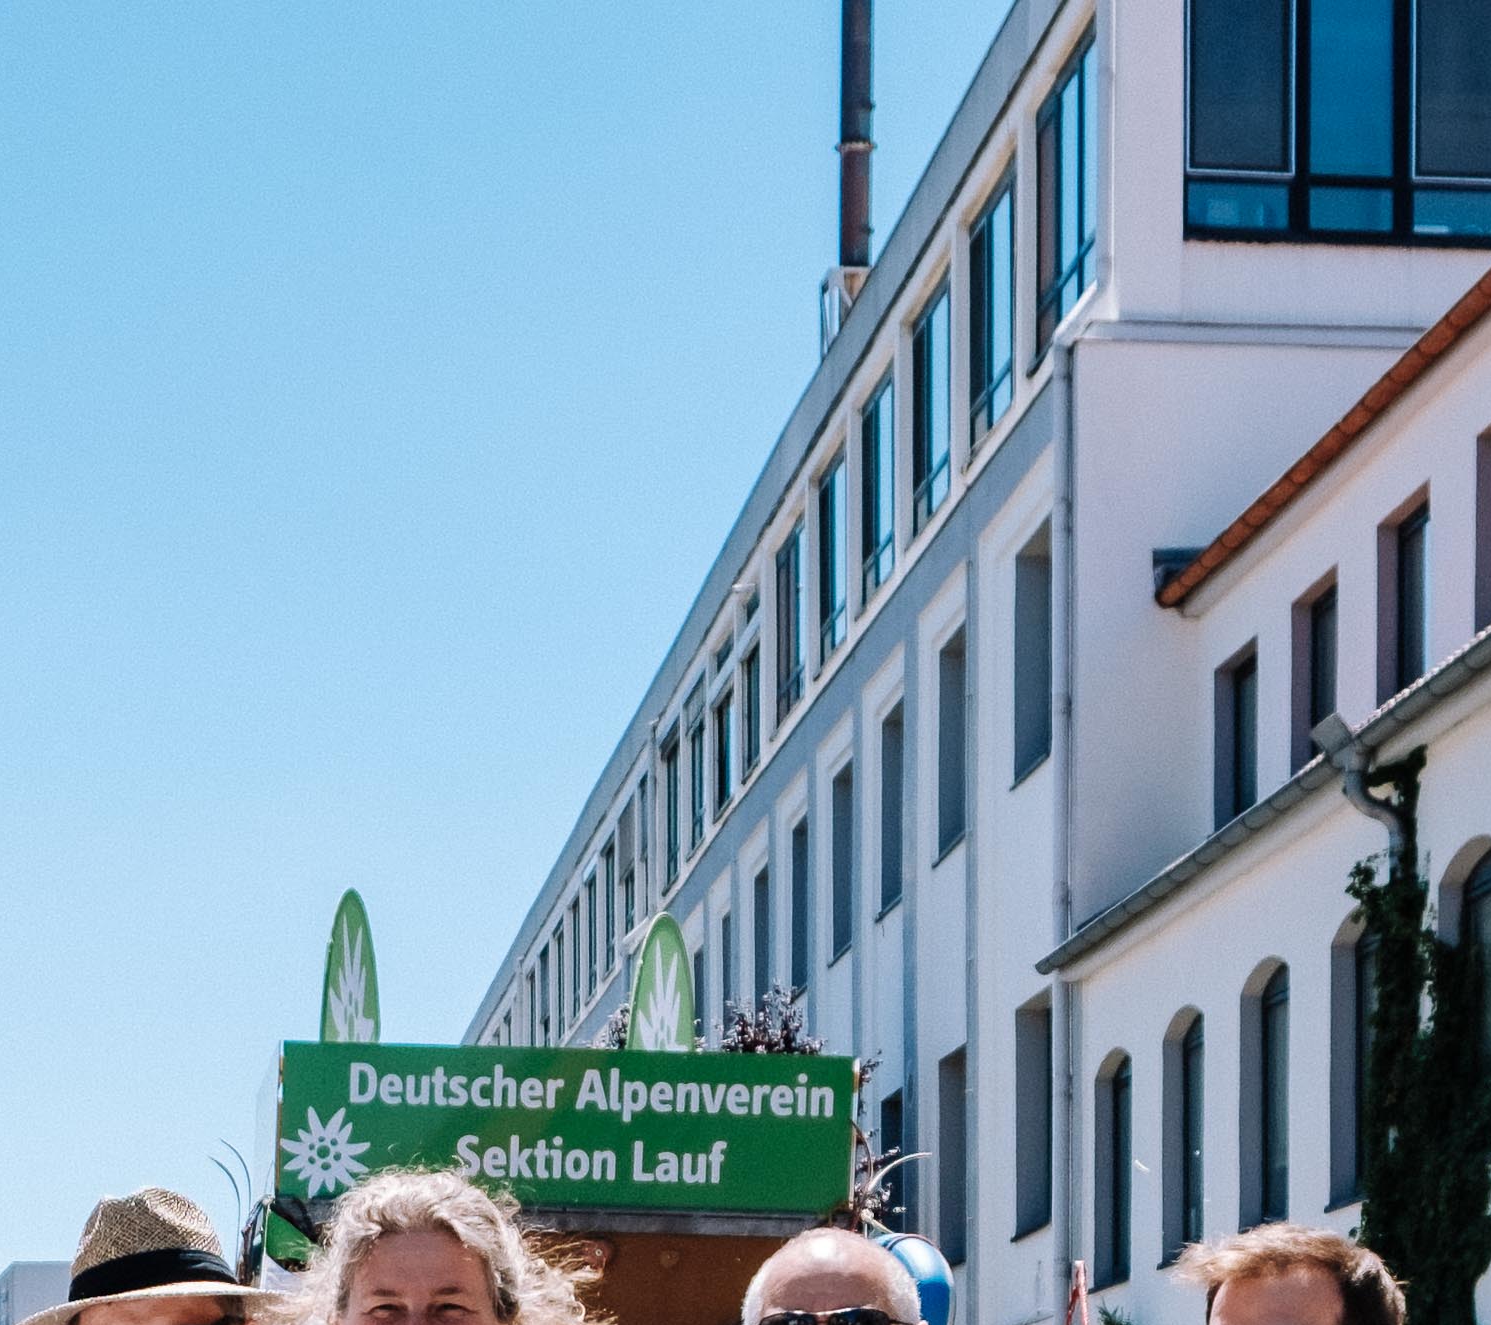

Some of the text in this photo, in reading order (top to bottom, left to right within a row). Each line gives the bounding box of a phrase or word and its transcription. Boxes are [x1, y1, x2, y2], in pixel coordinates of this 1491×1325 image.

[348, 1062, 835, 1121] Deutscher Alpenverein
[455, 1134, 727, 1184] Sektion Lauf
